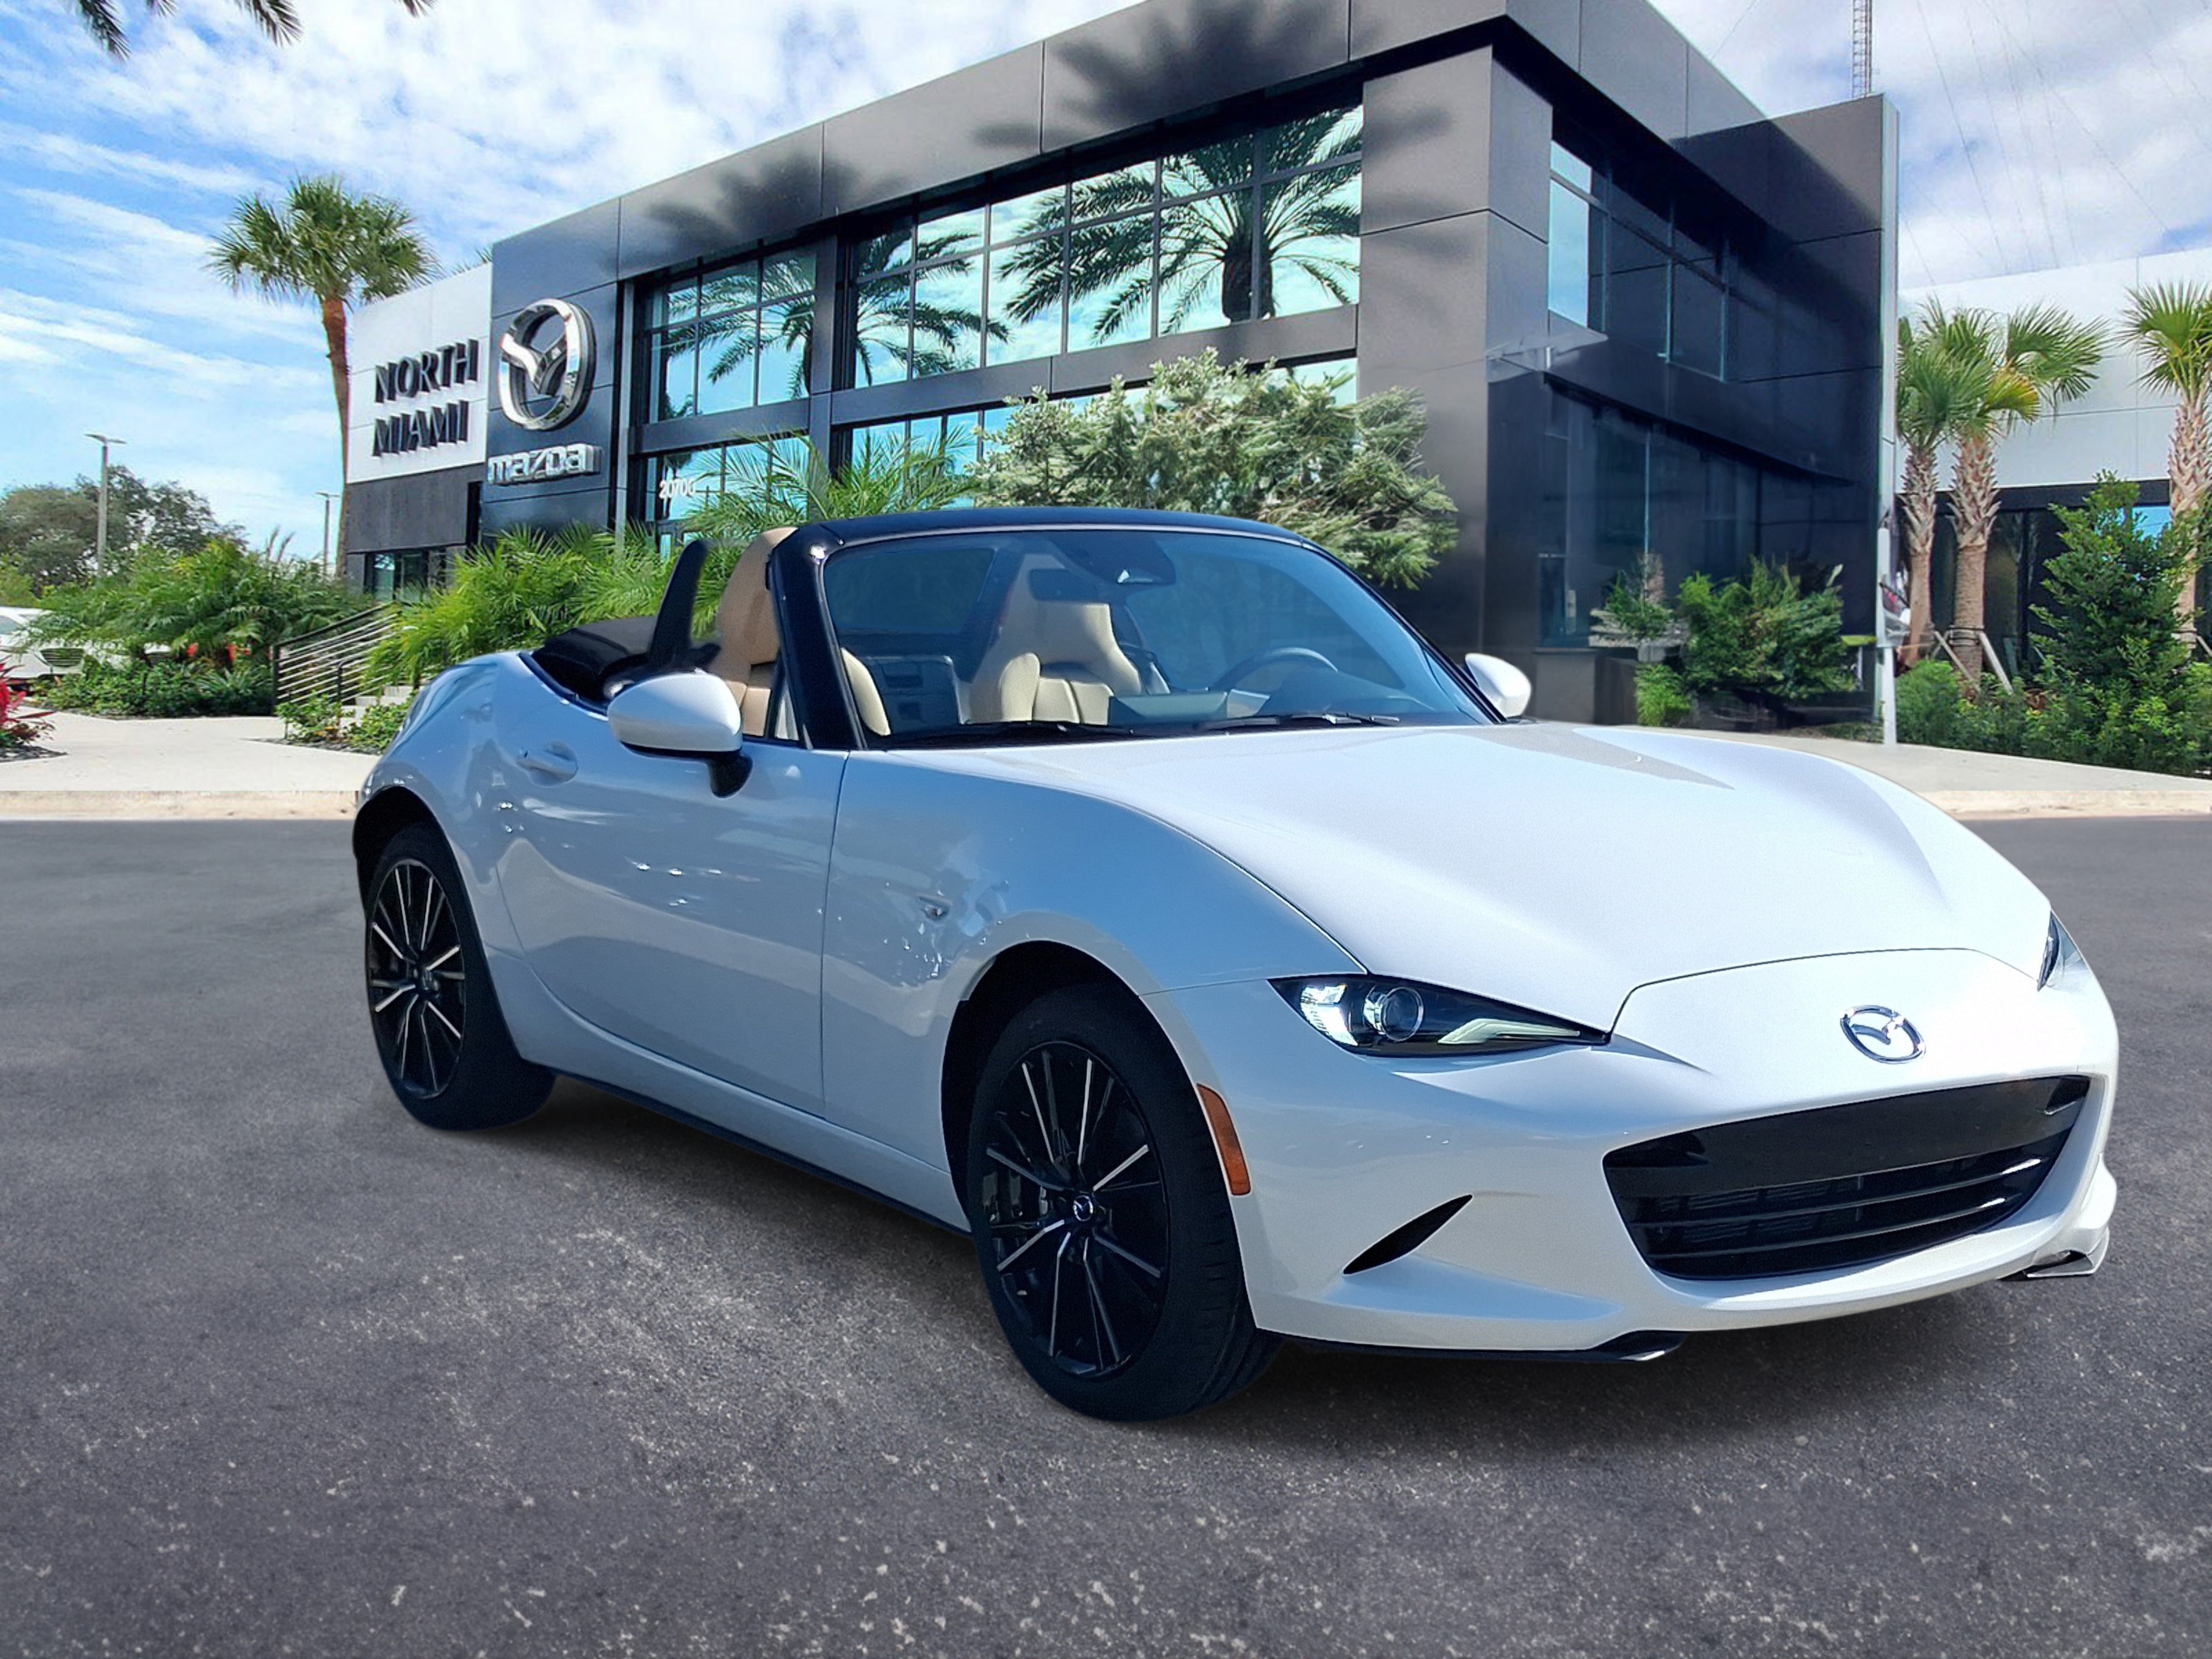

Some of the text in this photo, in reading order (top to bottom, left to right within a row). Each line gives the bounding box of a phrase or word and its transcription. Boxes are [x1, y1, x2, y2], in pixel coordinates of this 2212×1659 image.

[375, 338, 479, 403] NORTH
[372, 400, 469, 457] MIAMI
[487, 443, 594, 484] mazda
